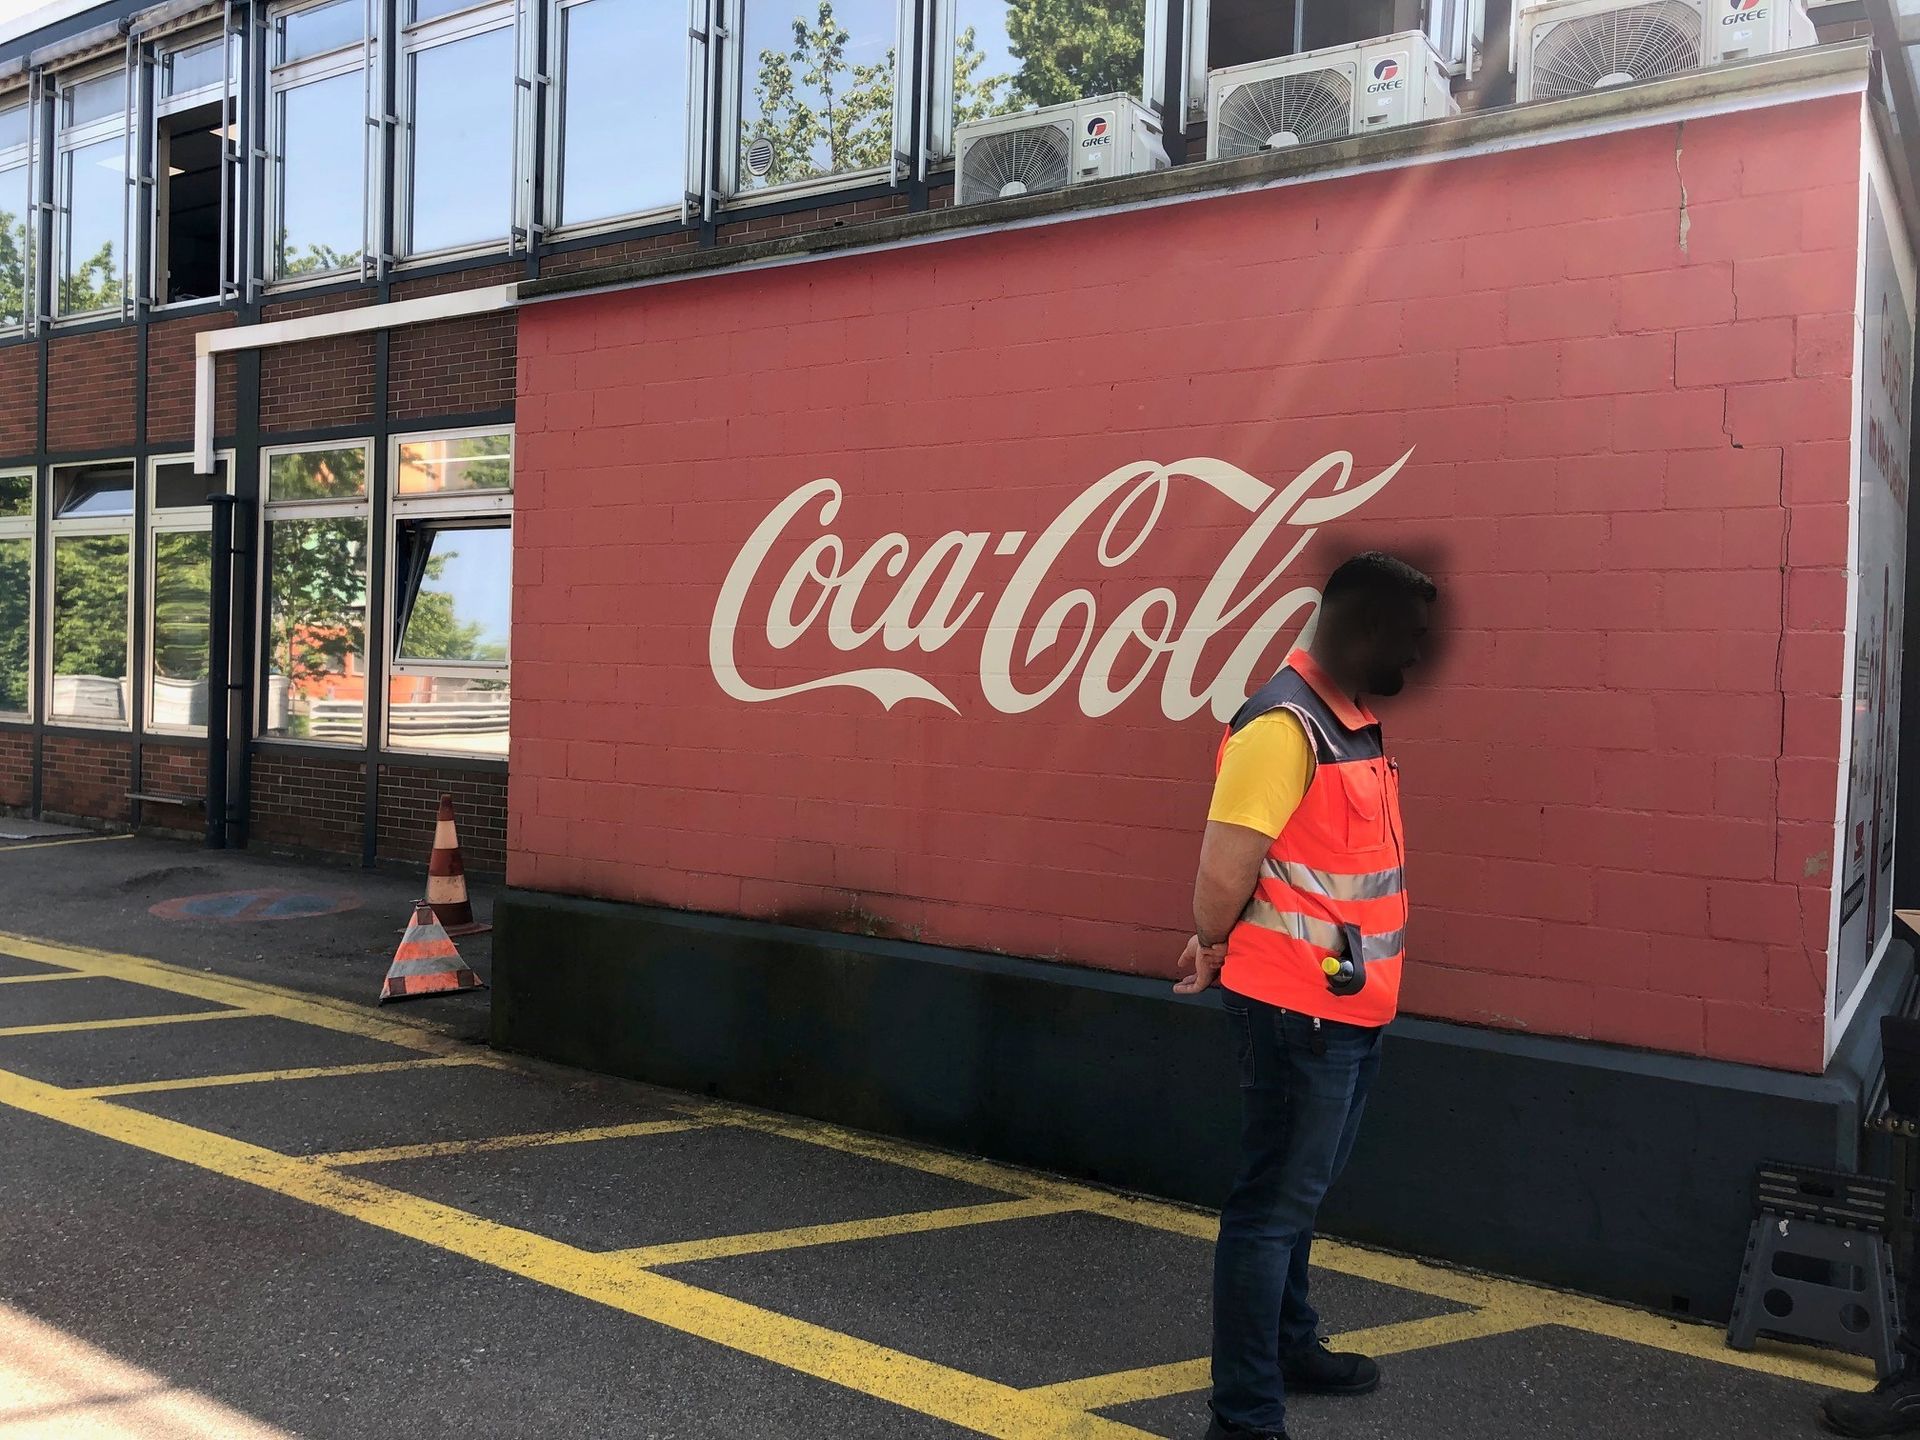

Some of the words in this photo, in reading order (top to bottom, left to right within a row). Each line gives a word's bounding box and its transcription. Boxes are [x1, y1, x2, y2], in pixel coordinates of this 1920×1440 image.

[1722, 8, 1768, 26] GREE
[1367, 79, 1403, 94] GREE
[1081, 135, 1111, 148] GREE
